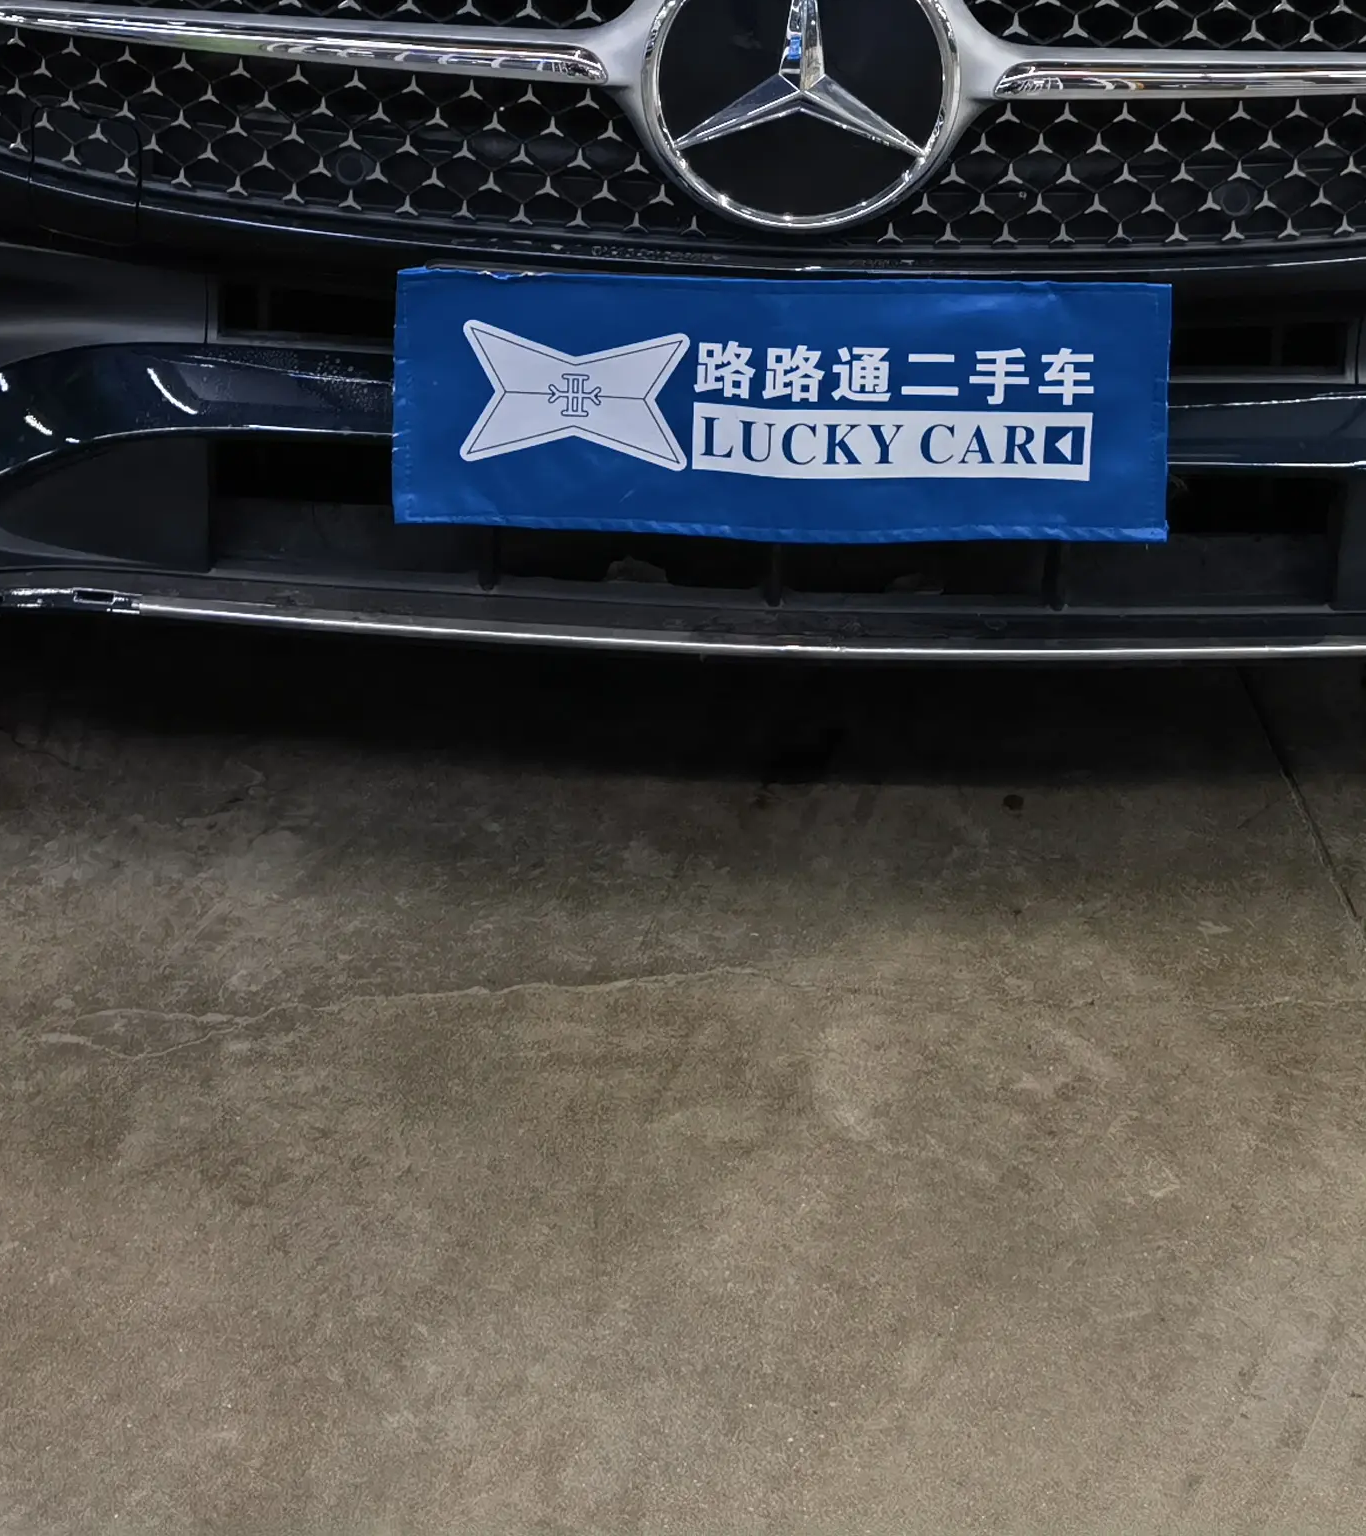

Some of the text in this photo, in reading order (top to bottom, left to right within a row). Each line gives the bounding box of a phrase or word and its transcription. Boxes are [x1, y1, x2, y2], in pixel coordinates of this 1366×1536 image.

[693, 342, 1096, 406] 路路通二手车
[702, 416, 1039, 468] LUCKY CAR
